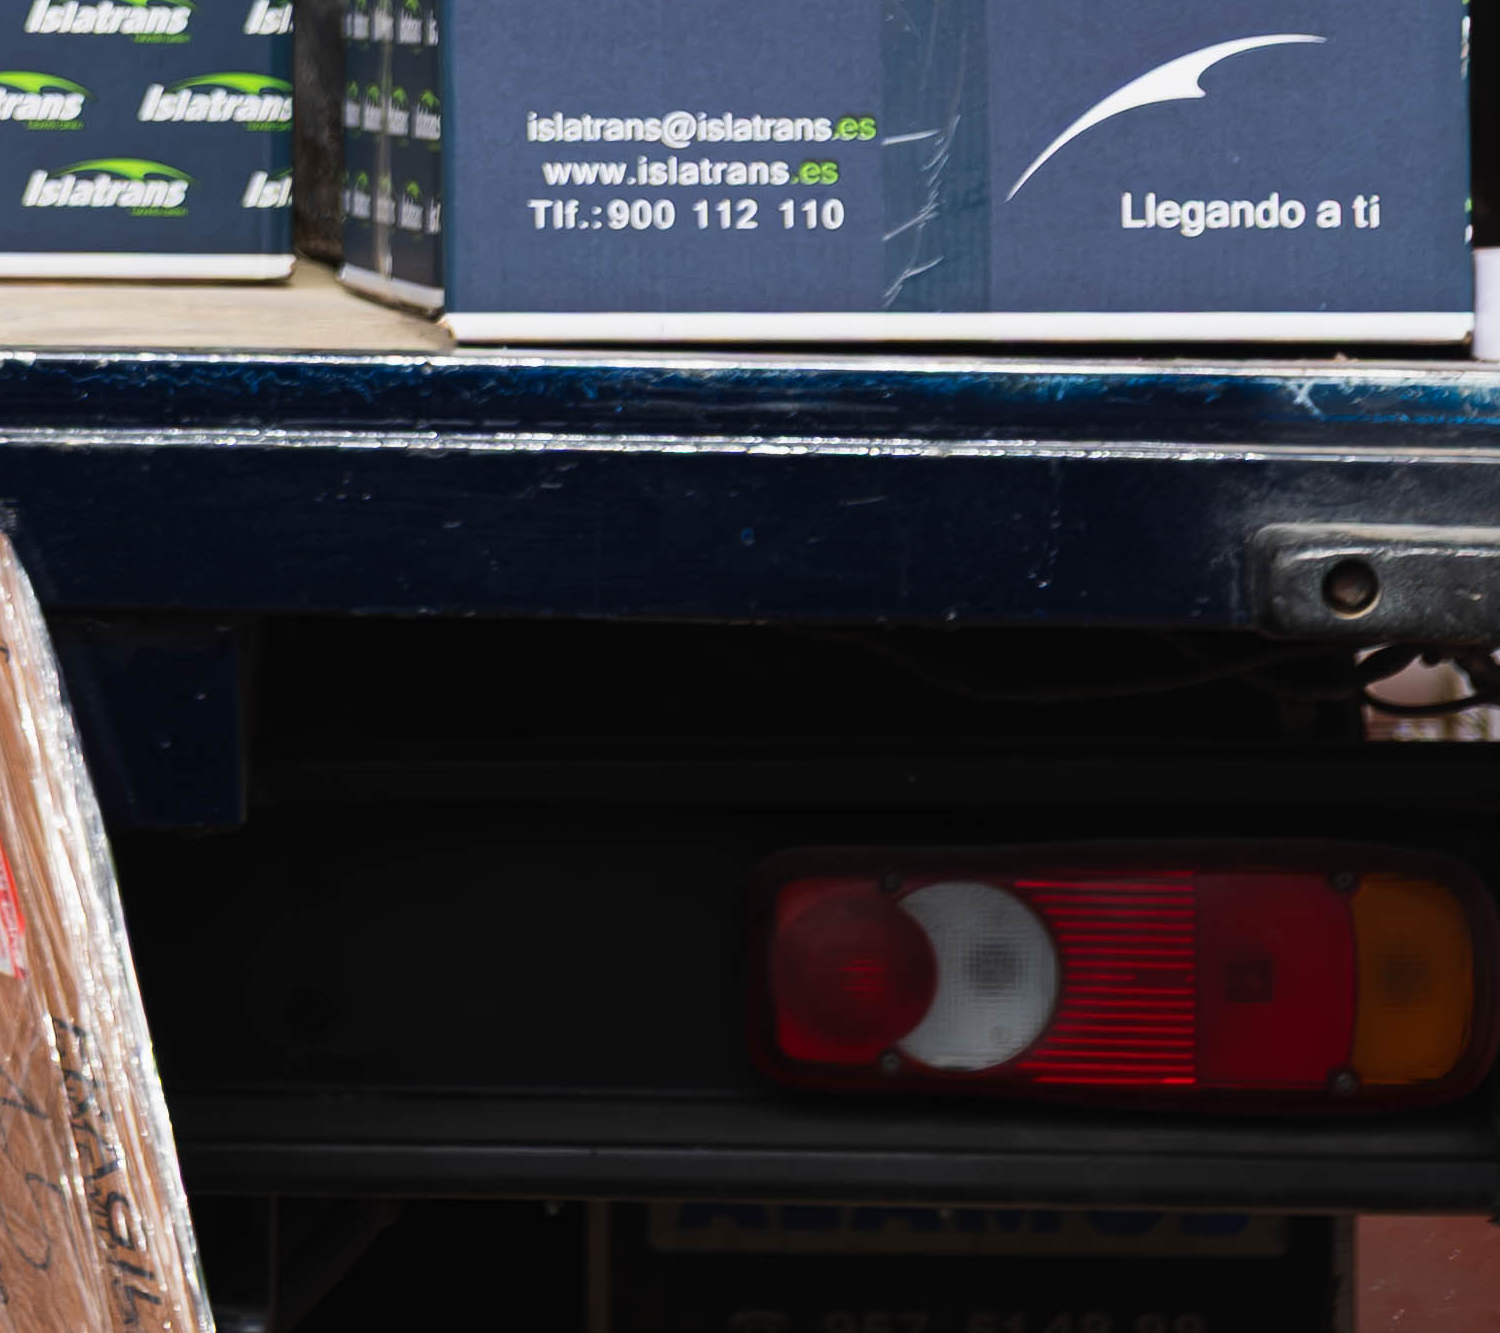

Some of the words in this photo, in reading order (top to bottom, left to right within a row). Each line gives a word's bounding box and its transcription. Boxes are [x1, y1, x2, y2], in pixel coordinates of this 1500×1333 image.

[526, 110, 878, 149] islatrans@islatrans.es
[22, 169, 190, 209] Islatrans
[542, 155, 840, 186] www.islatrans.es
[691, 198, 759, 230] 112
[778, 198, 845, 230] 110
[1120, 191, 1307, 238] Llegando
[1315, 199, 1343, 229] a
[1351, 193, 1382, 229] ti
